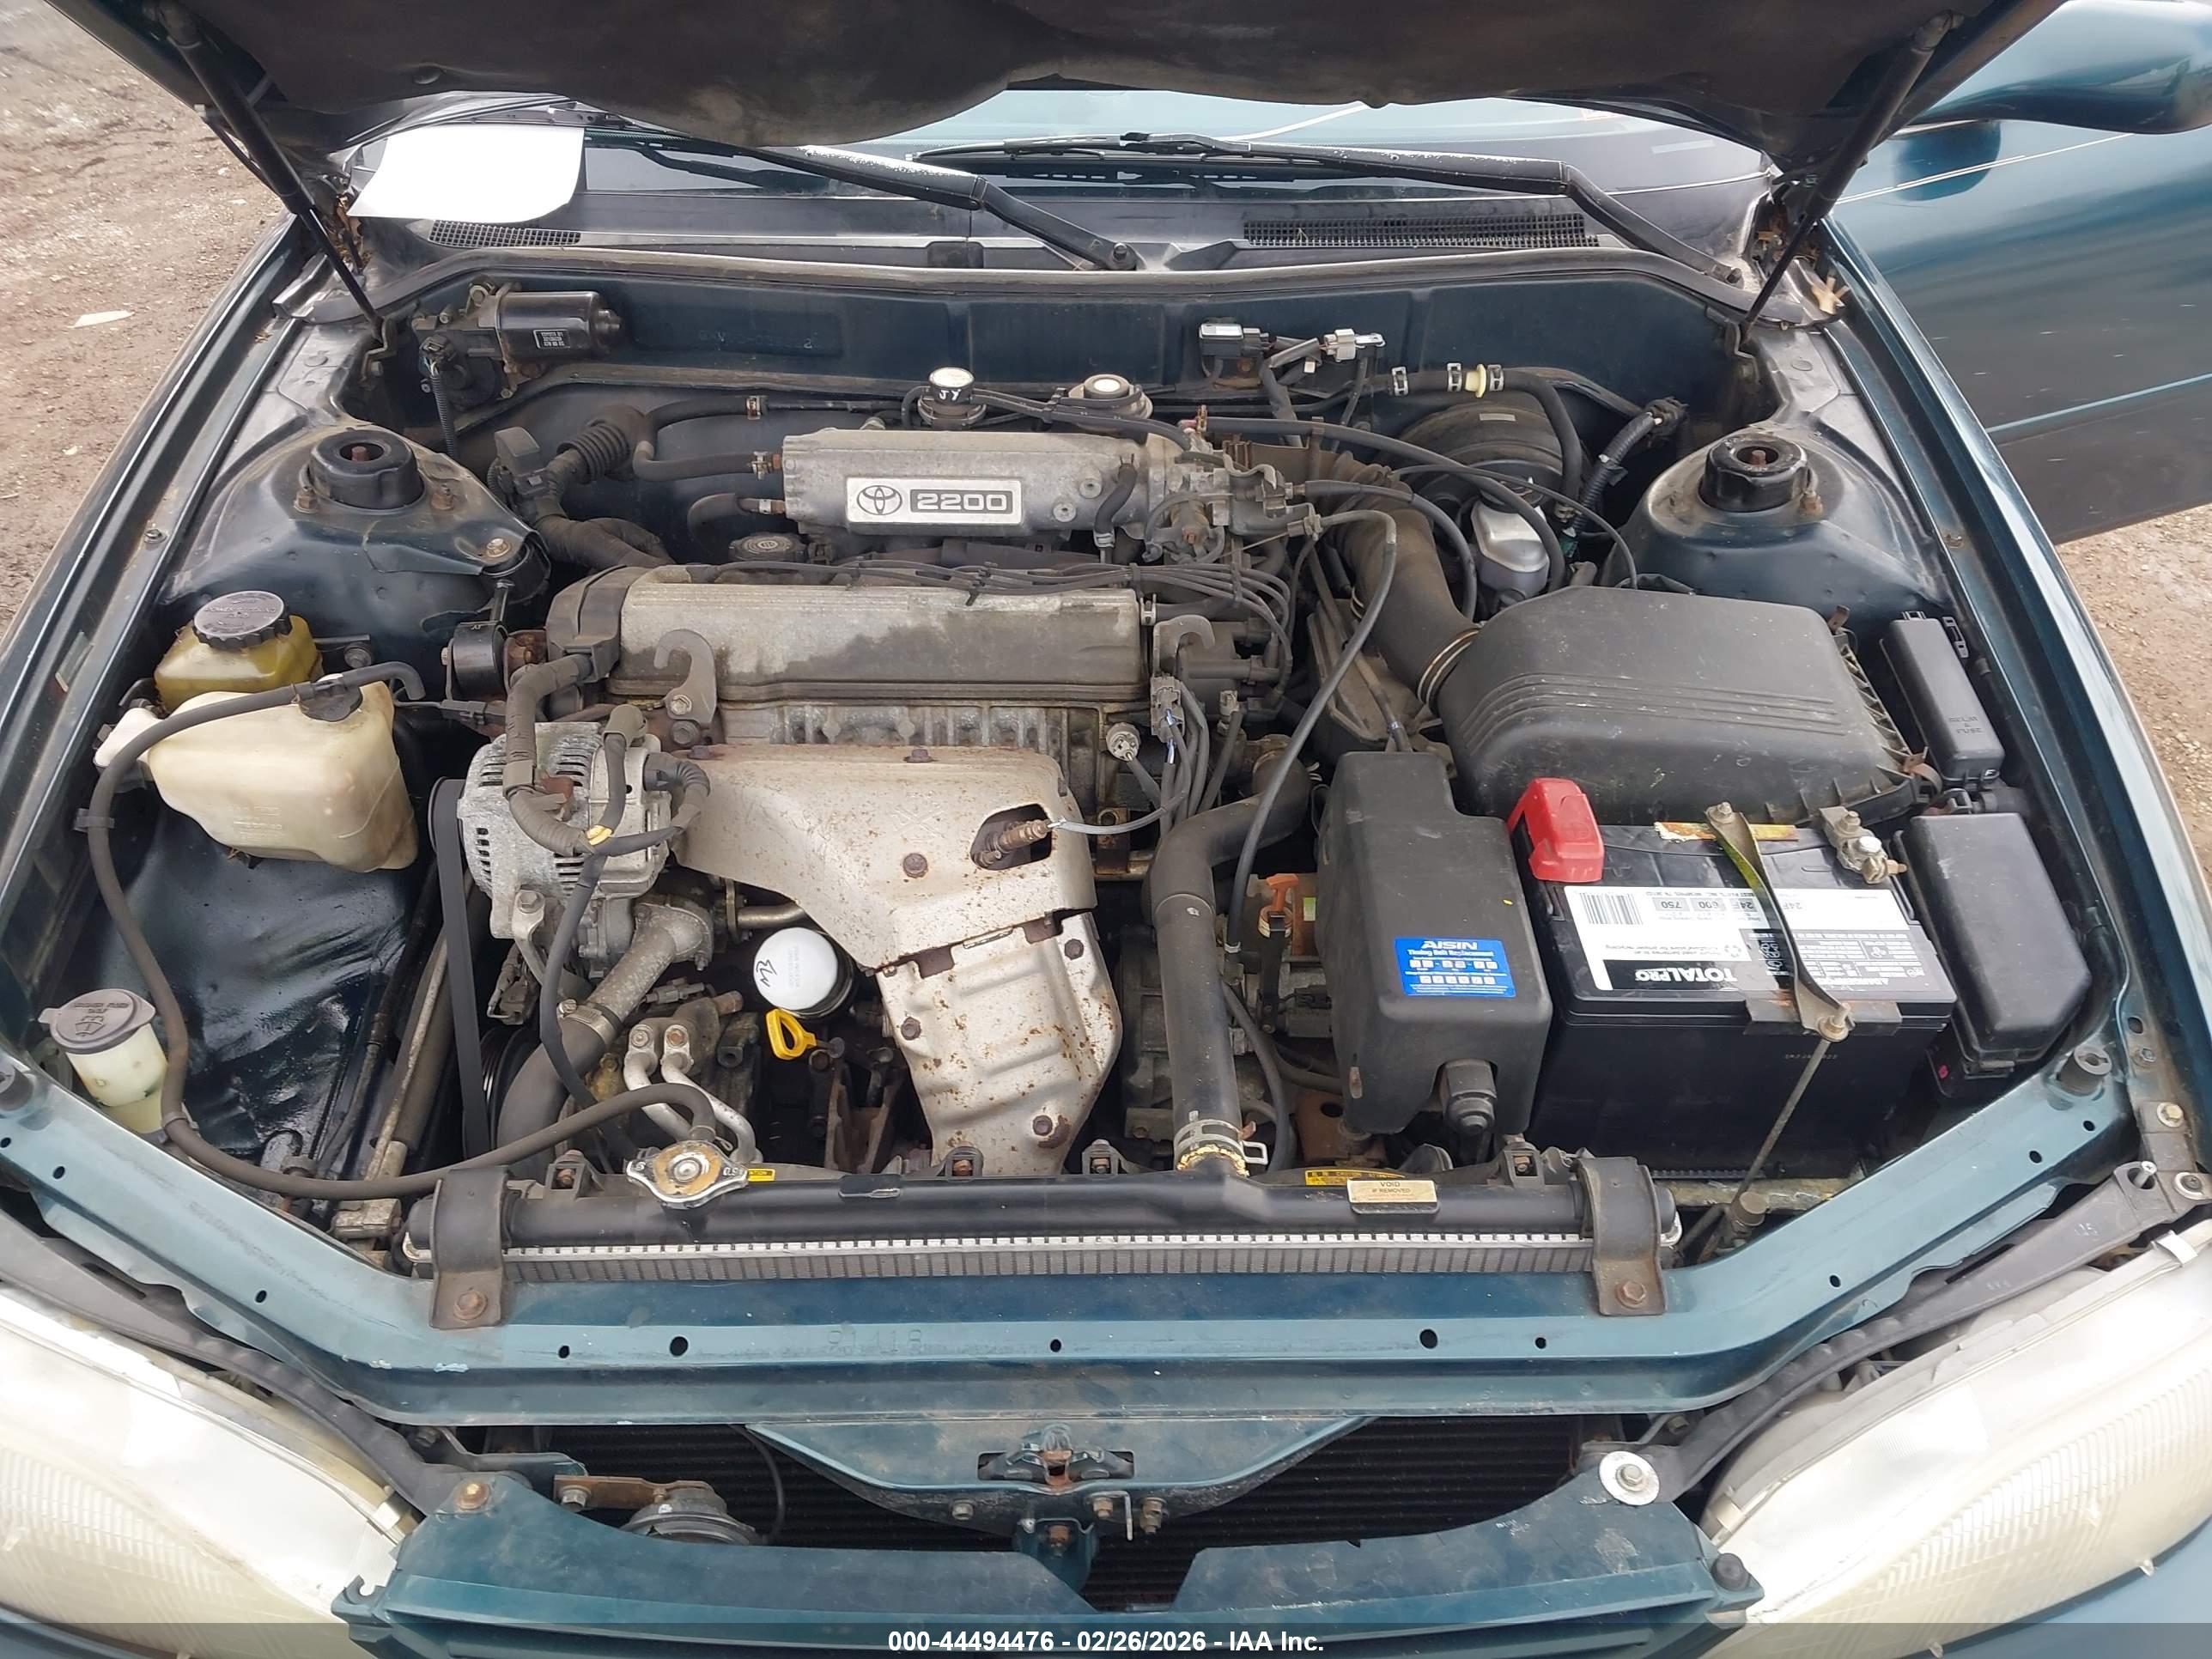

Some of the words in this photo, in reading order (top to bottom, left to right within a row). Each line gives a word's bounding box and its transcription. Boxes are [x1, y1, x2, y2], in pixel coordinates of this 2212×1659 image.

[917, 493, 1007, 511] 2200
[1661, 901, 1683, 909] 750
[1421, 940, 1478, 950] AISIN
